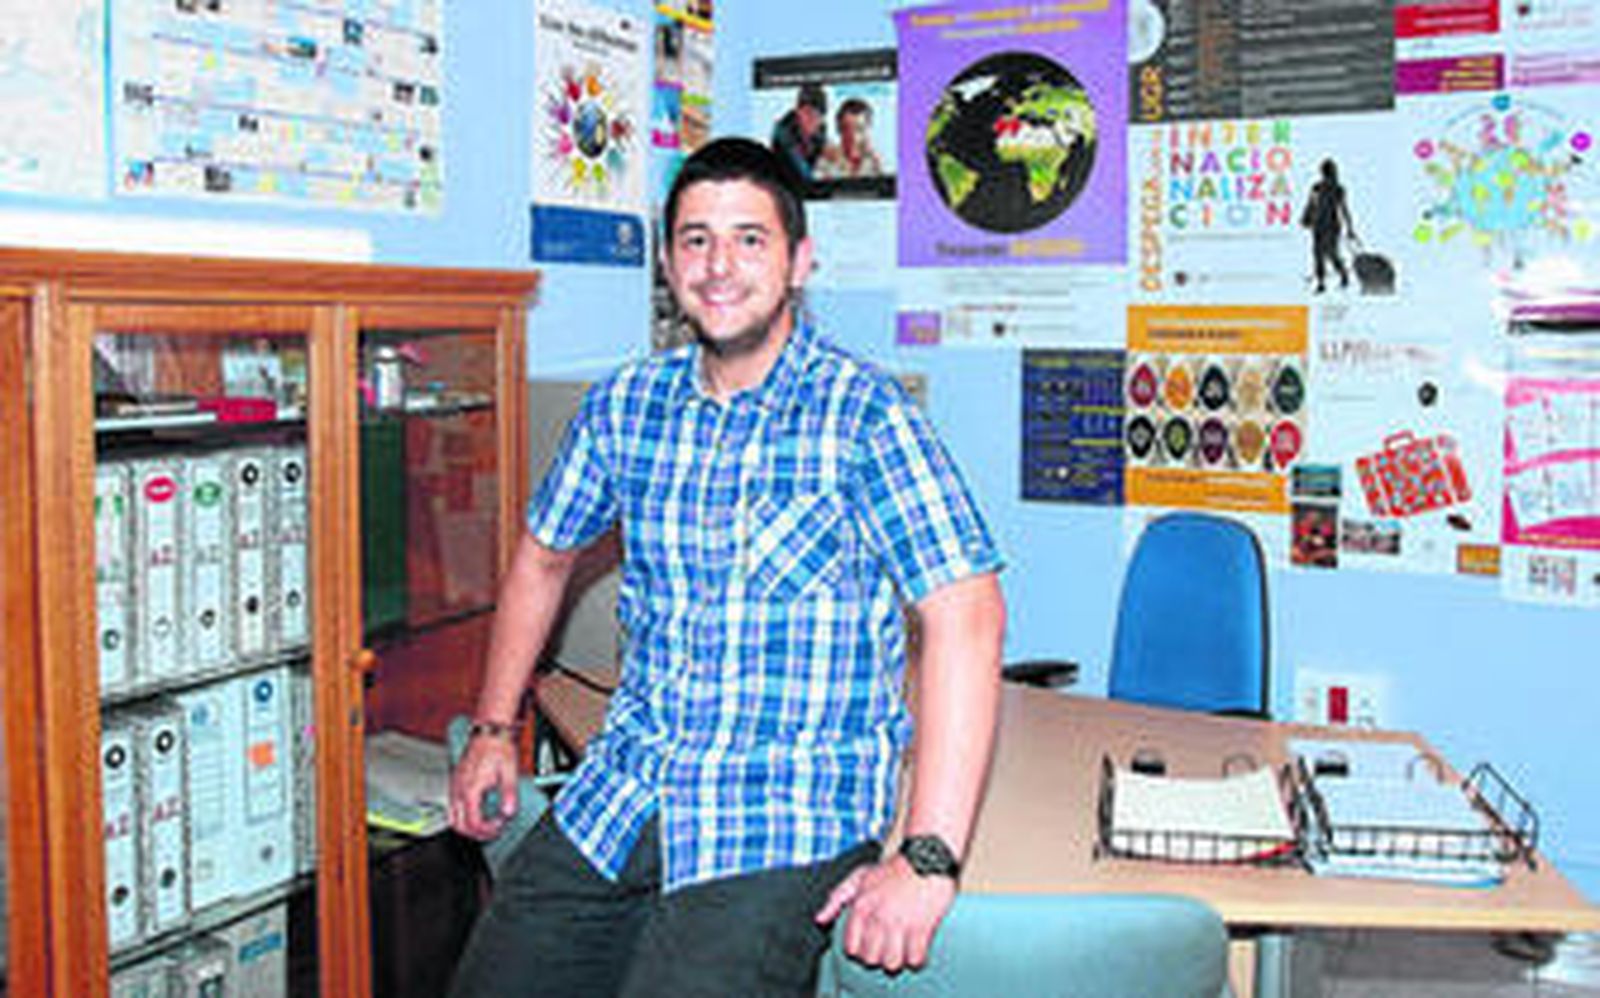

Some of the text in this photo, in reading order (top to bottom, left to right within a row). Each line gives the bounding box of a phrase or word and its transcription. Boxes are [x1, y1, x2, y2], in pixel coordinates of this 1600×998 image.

[1139, 66, 1163, 121] UGR
[1169, 121, 1292, 147] INTER
[1169, 146, 1293, 174] NACIO
[1169, 174, 1293, 201] NALIZA
[1140, 177, 1162, 292] DESPEGA
